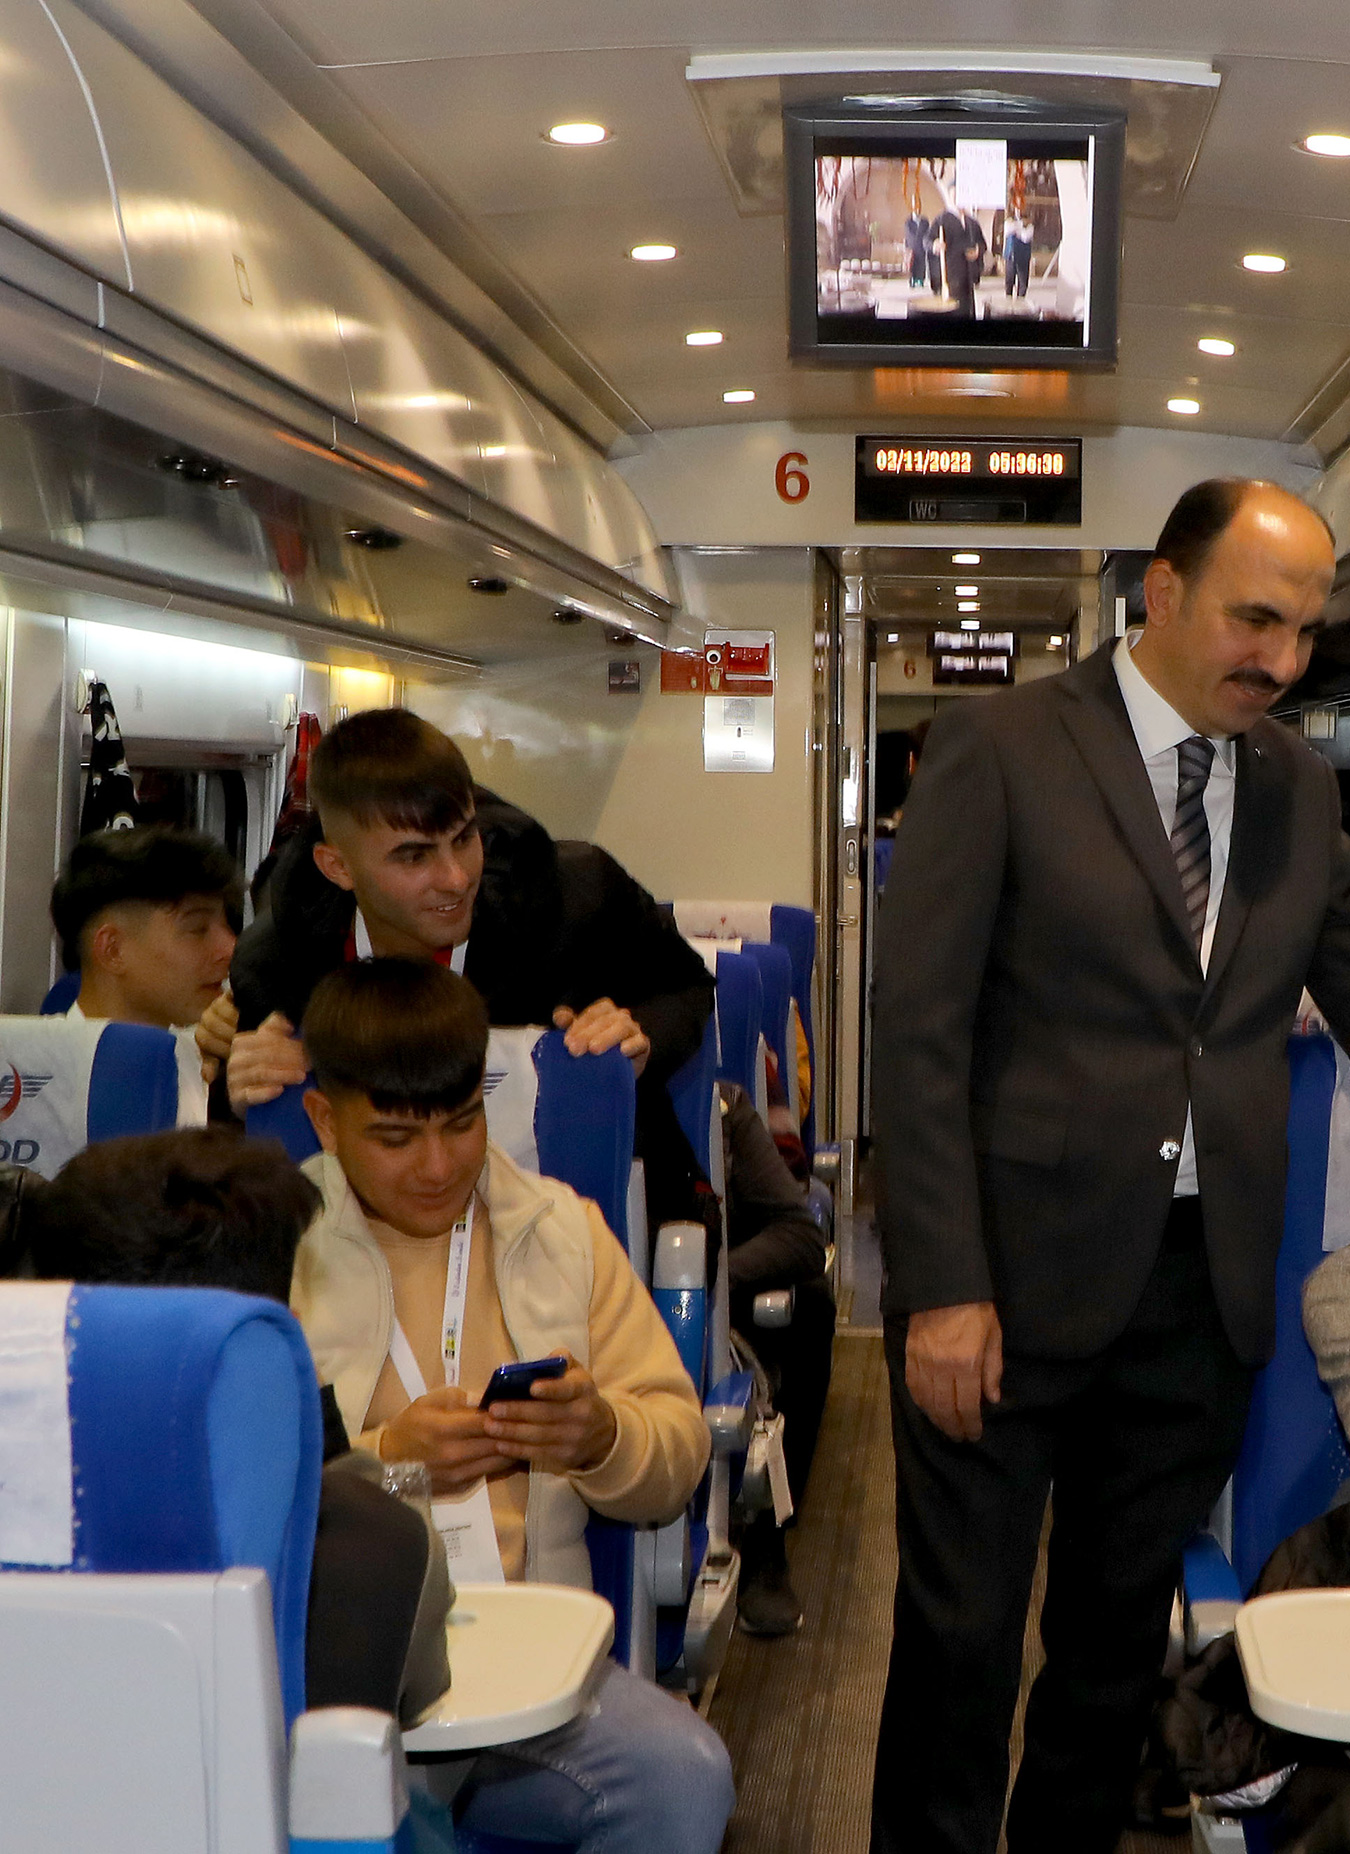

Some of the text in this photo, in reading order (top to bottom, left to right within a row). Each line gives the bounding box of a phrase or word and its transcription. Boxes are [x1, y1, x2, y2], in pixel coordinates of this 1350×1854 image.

[876, 448, 972, 475] 02/11/2022
[775, 451, 810, 505] 6
[914, 502, 938, 520] WC
[903, 658, 918, 680] 6
